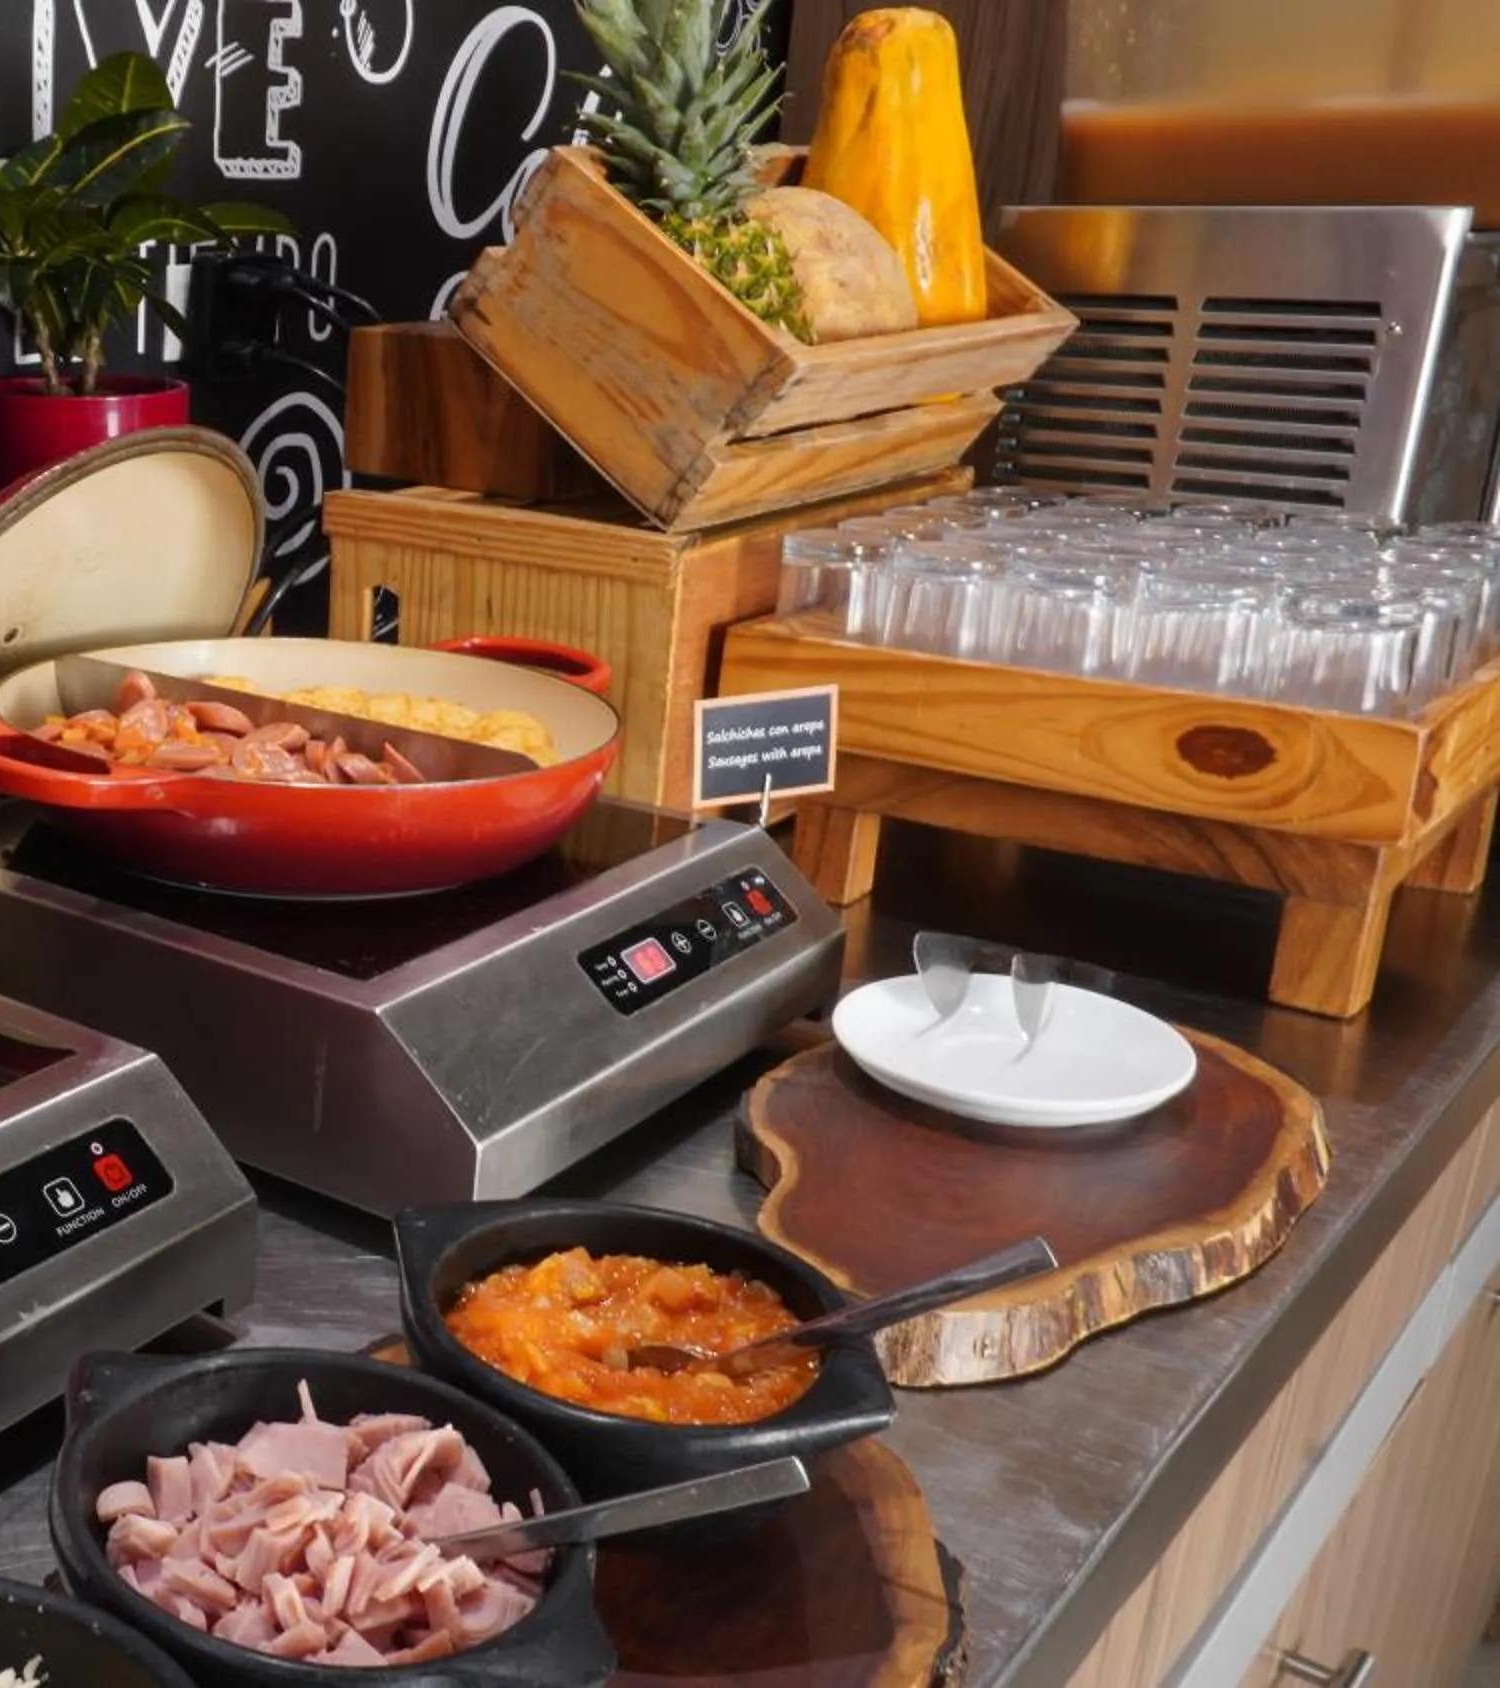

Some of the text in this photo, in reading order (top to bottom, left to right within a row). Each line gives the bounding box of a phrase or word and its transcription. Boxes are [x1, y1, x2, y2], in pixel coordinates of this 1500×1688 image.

[706, 719, 825, 745] Salchichas con arepa
[707, 743, 822, 769] Sausages with arepa
[55, 1206, 105, 1236] FUNCTION
